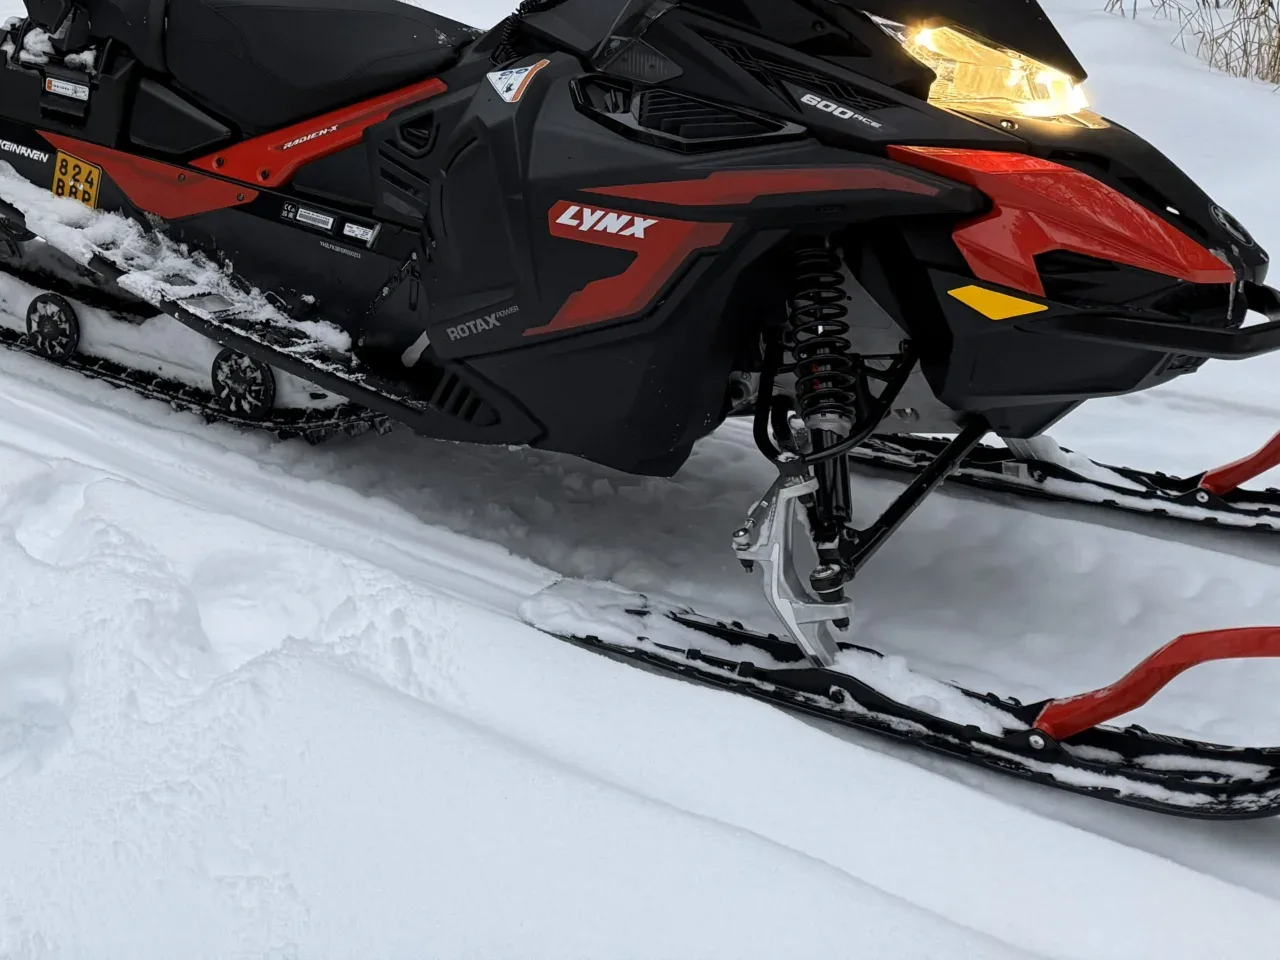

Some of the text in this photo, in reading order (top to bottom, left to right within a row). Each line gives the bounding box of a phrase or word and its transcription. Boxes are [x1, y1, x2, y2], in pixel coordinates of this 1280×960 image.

[800, 93, 882, 128] 600 ACE
[283, 124, 339, 149] RADIEN-X
[58, 158, 94, 189] 824
[555, 205, 659, 239] LYNX
[446, 305, 519, 341] ROTAX POWER
